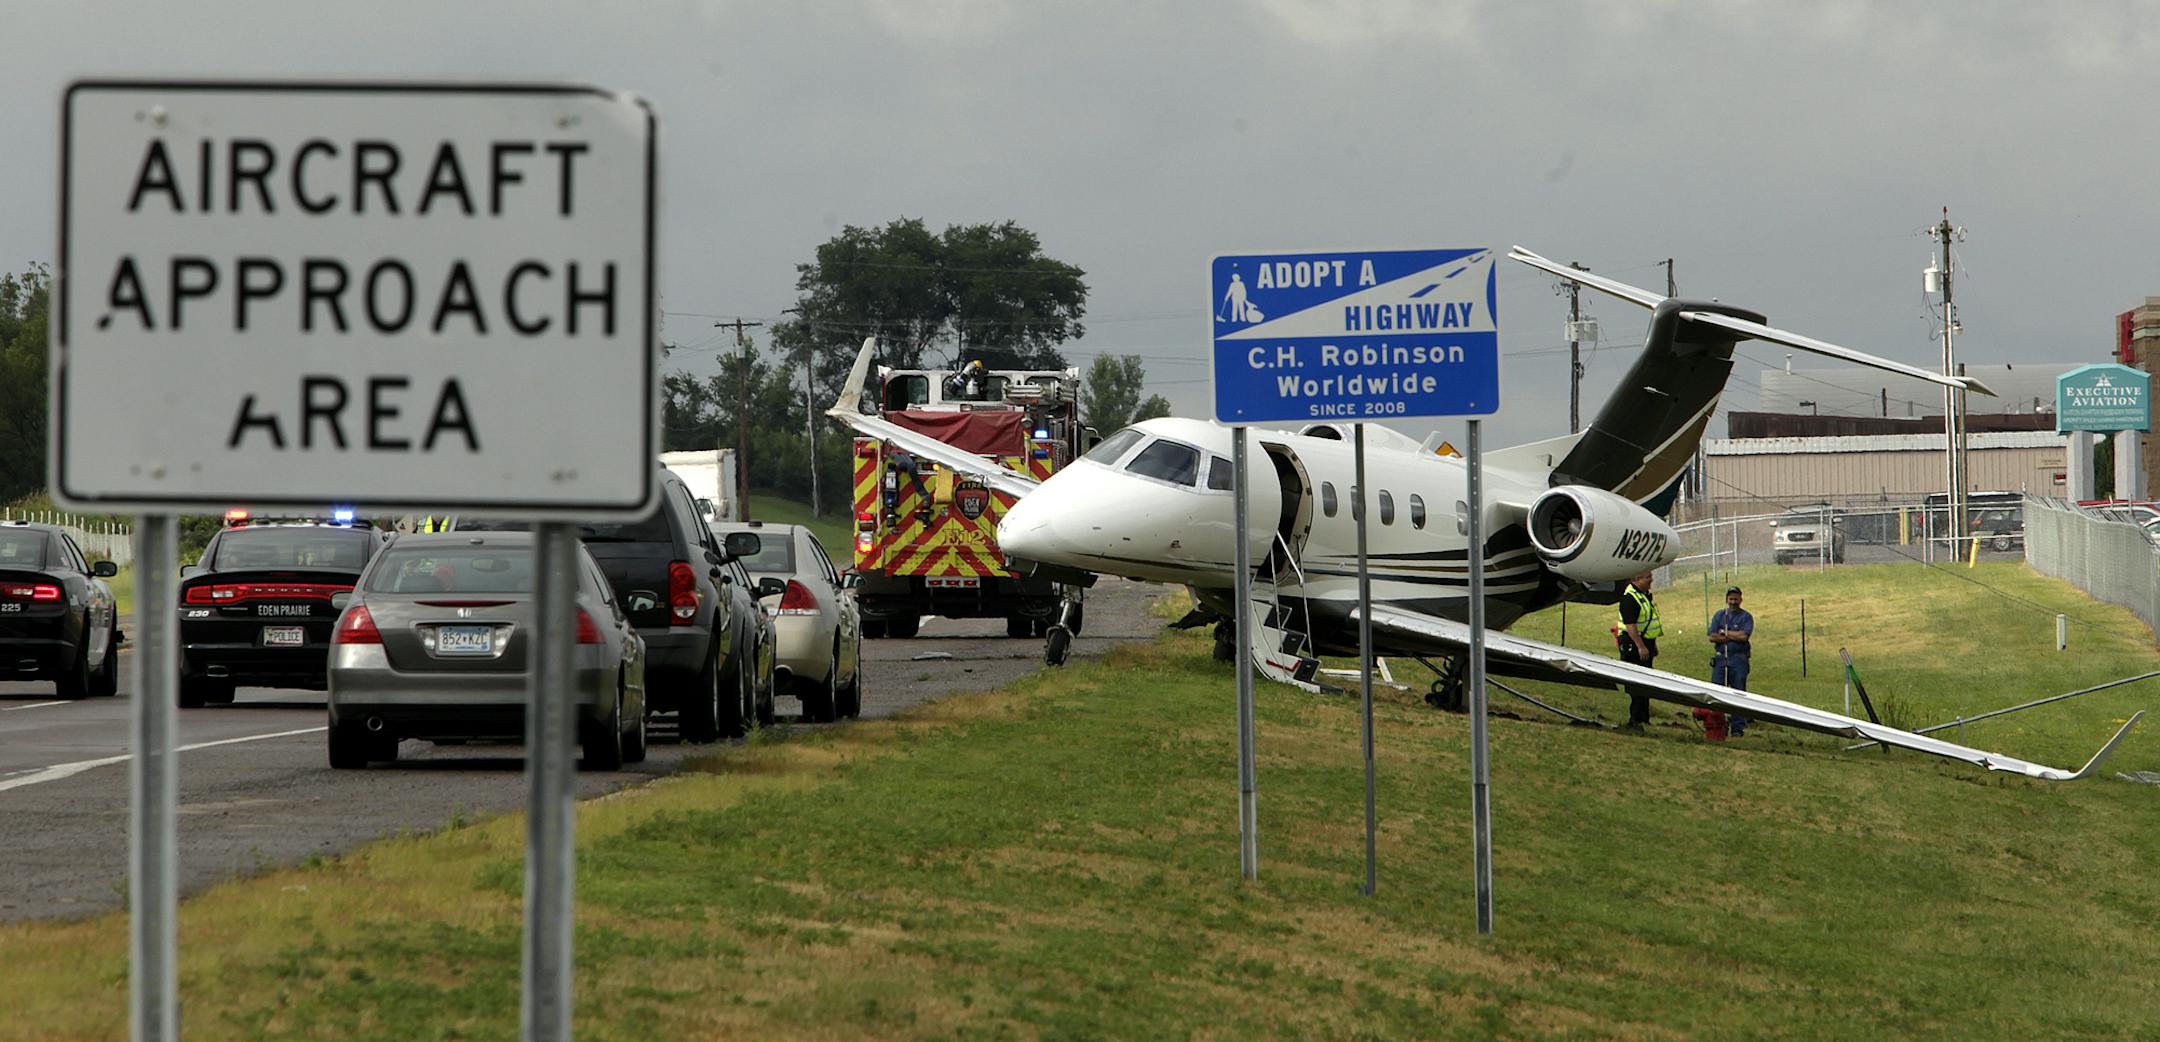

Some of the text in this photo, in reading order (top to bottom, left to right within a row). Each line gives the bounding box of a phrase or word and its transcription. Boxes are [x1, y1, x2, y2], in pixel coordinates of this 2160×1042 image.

[127, 137, 591, 216] AIRCRAFT
[1257, 259, 1377, 289] ADOPT A
[96, 256, 618, 336] APPROACH
[1345, 302, 1473, 331] HIGHWAY
[1248, 344, 1465, 369] C.H. Robinson
[1277, 373, 1437, 398] Worldwide
[2066, 387, 2142, 397] EXECUTIVE
[1310, 402, 1406, 416] SINCE 2008
[2072, 397, 2137, 406] AVIATION
[227, 376, 481, 453] AREA
[1612, 529, 1667, 562] N327FL
[1, 603, 21, 612] 225
[188, 610, 209, 618] 230
[258, 605, 311, 616] EDEN PRAIRIE
[273, 631, 300, 641] POLICE
